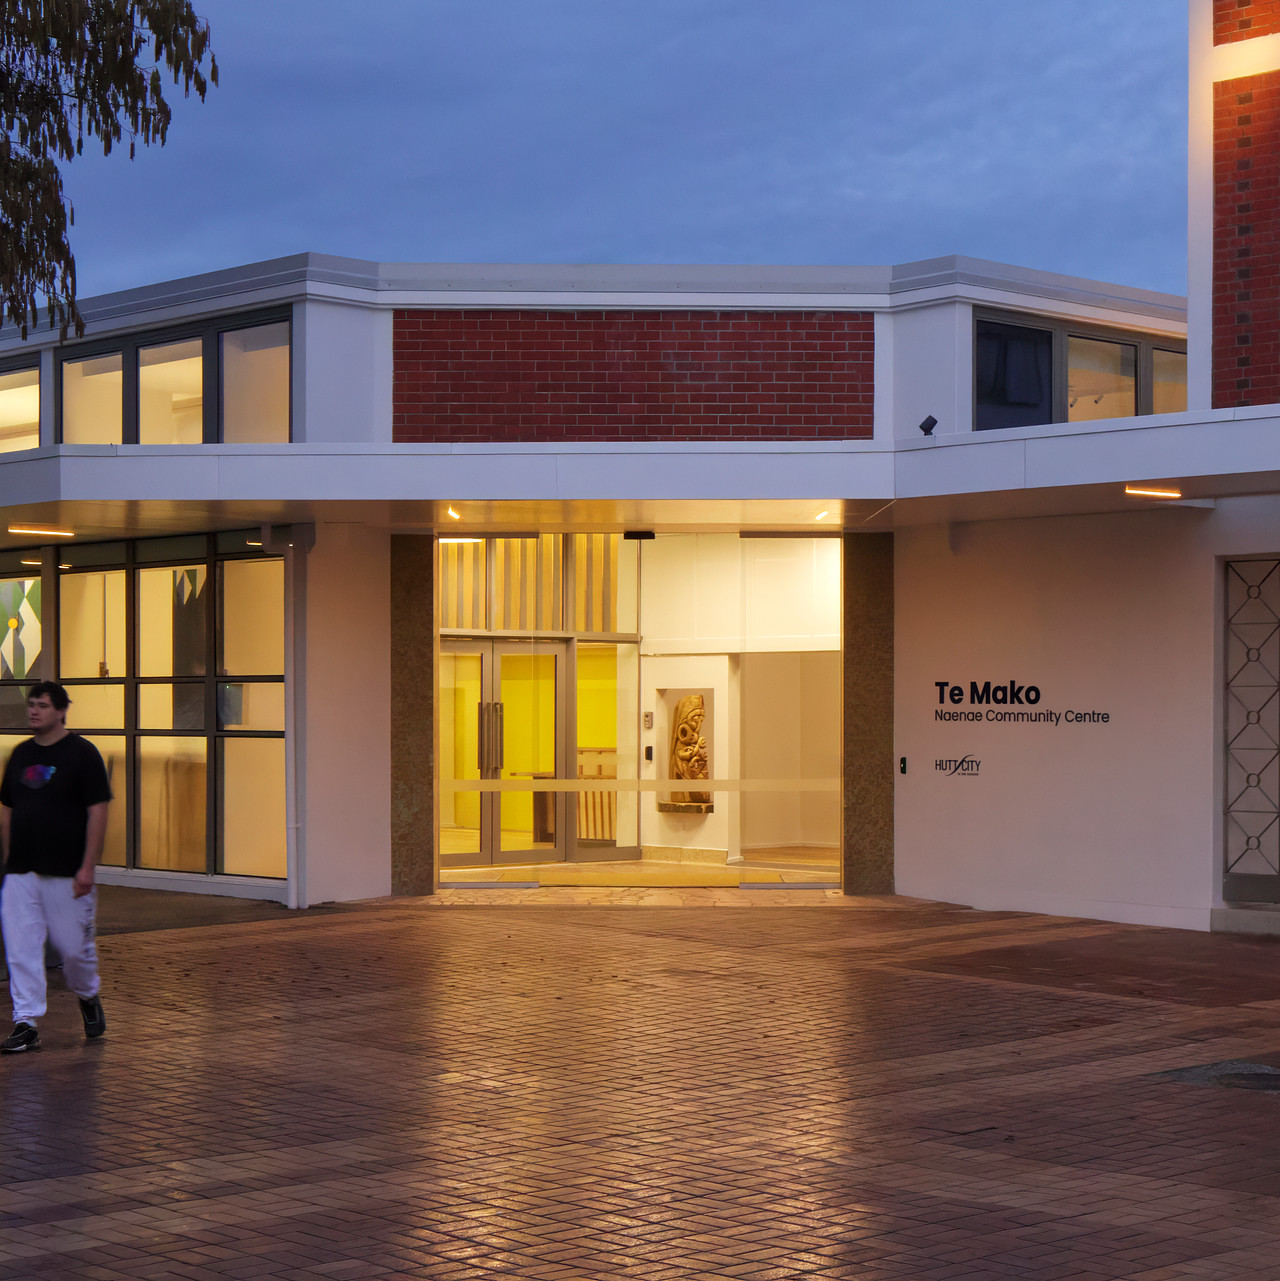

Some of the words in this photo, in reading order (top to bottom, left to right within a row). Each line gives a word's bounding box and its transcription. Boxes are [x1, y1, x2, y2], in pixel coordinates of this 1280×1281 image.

[935, 681, 964, 705] Te
[970, 680, 1041, 705] Mako
[935, 709, 983, 722] Naenae
[985, 709, 1062, 726] Community
[1064, 710, 1110, 723] Centre
[935, 759, 959, 771] HUTT
[961, 759, 981, 771] CITY
